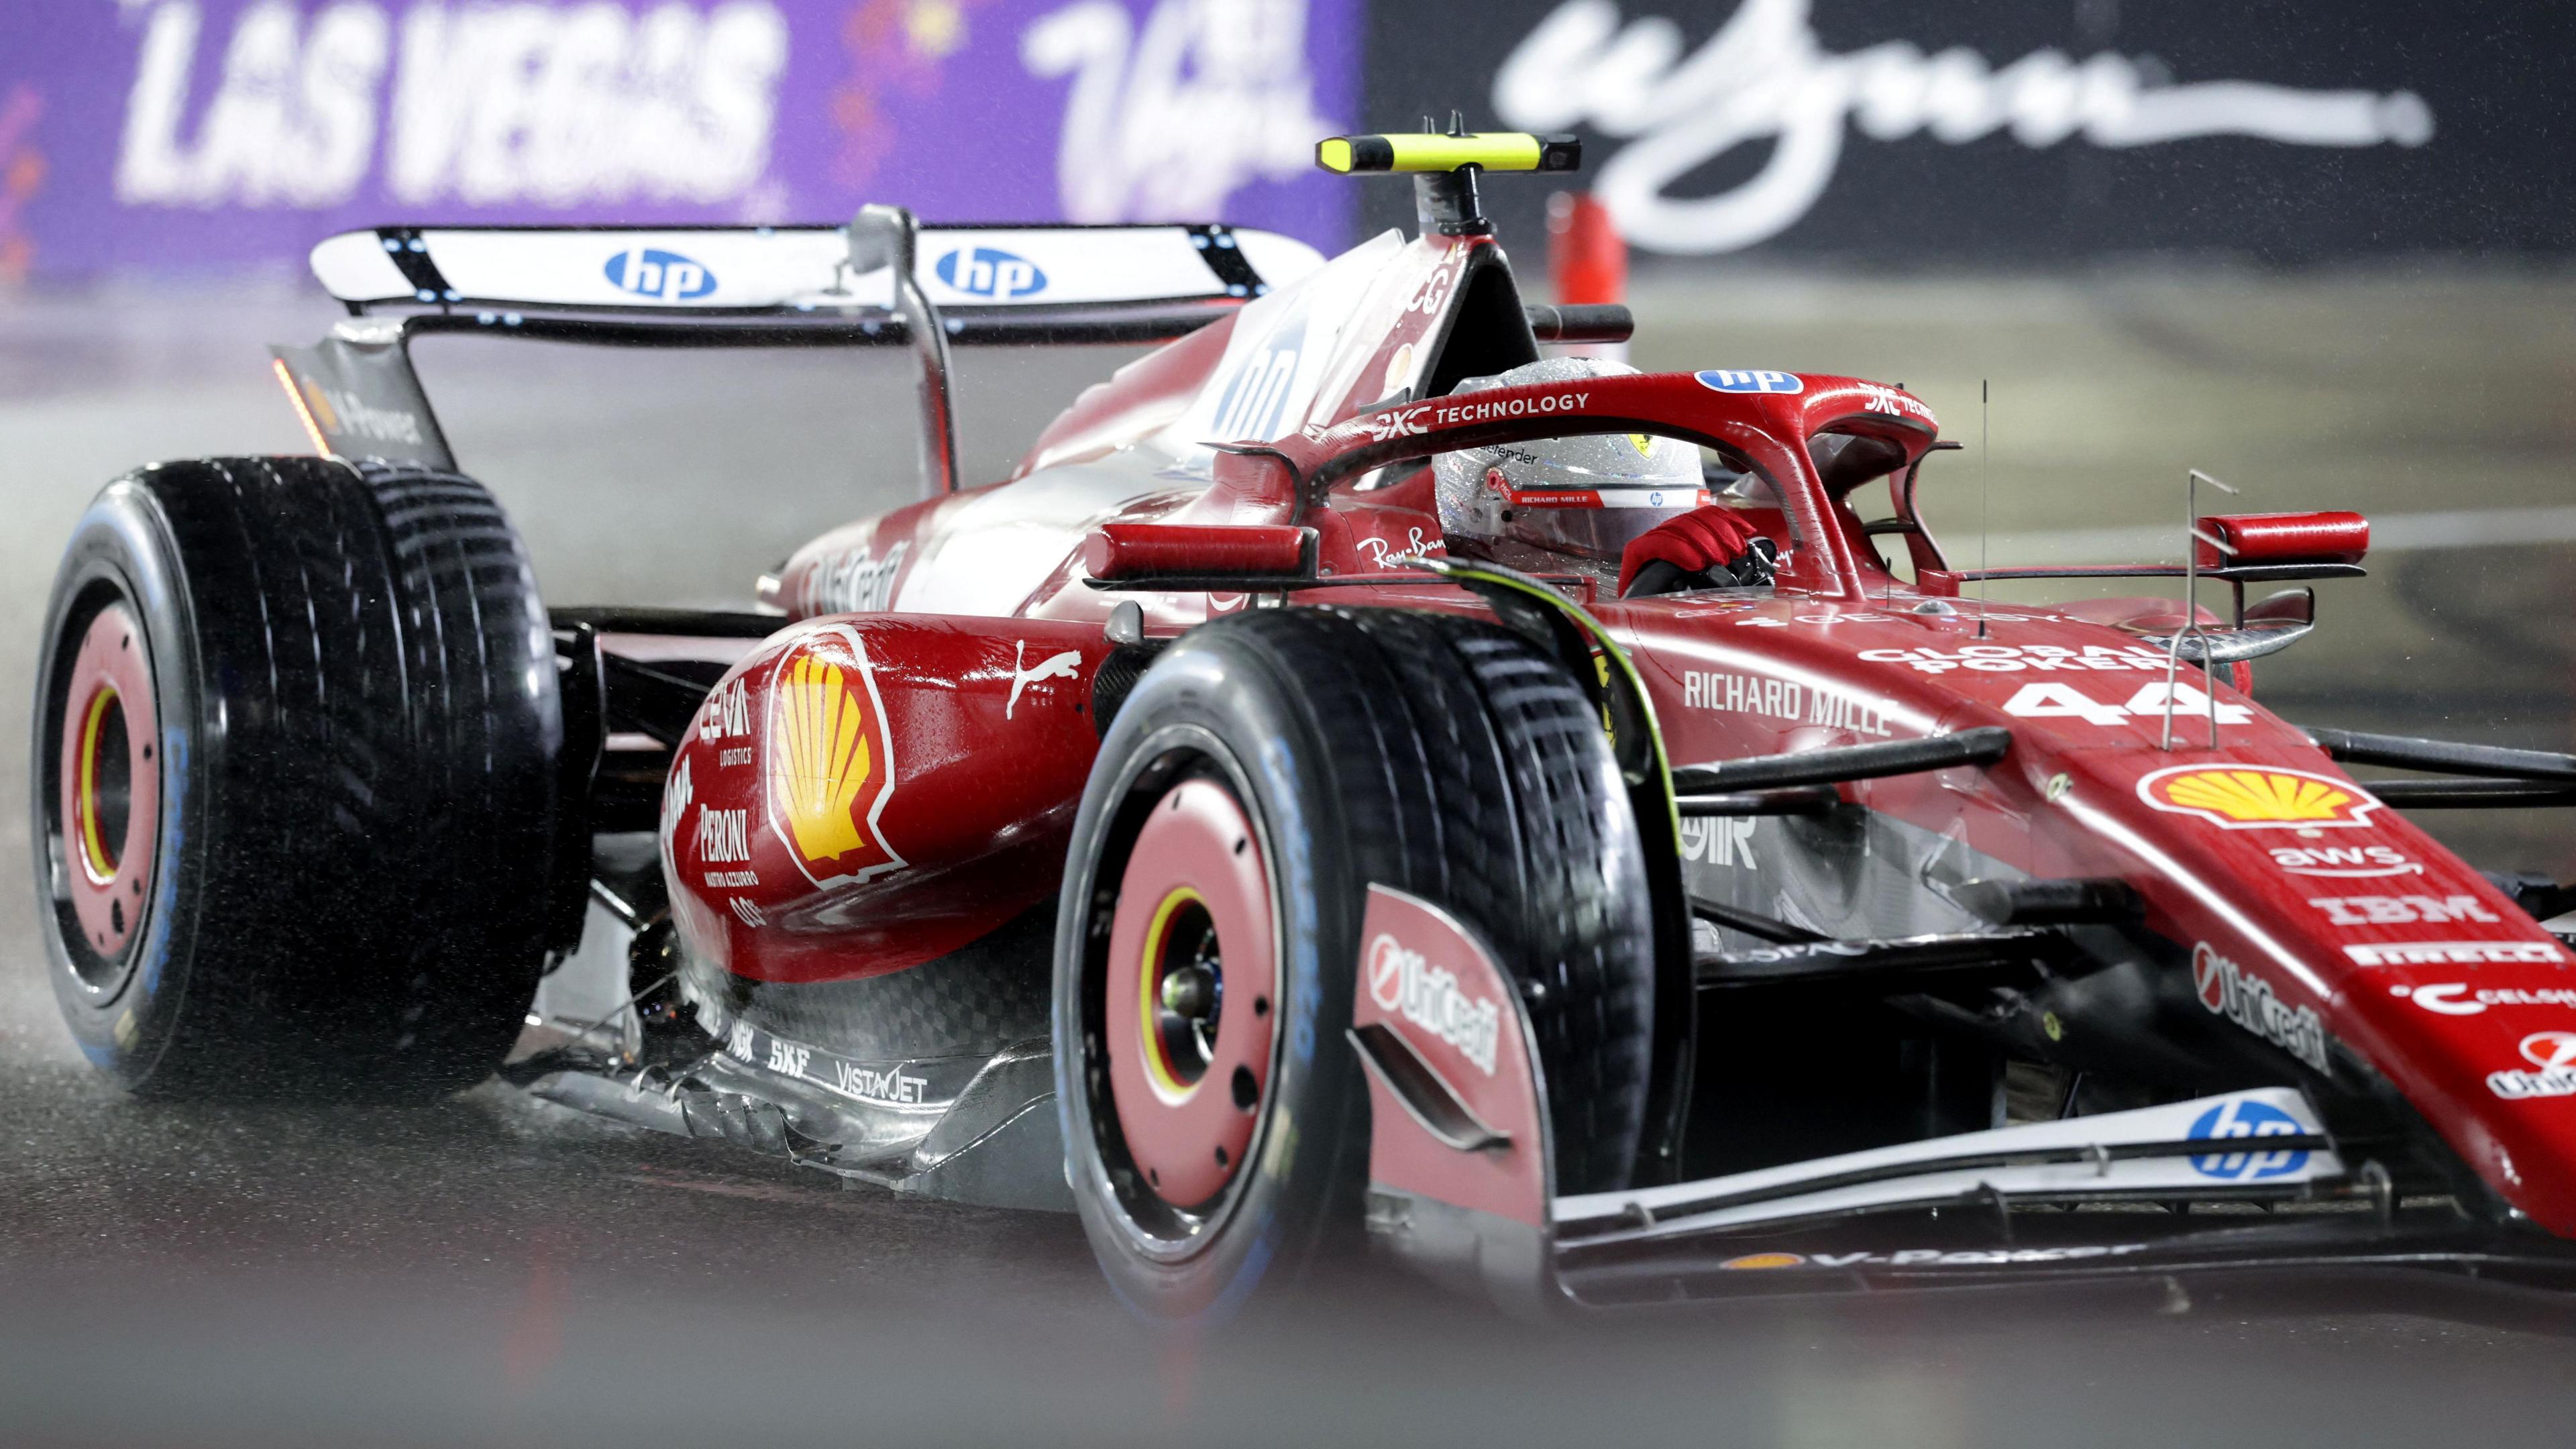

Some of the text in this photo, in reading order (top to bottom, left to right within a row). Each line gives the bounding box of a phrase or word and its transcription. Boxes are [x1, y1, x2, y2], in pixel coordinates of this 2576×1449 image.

[115, 0, 389, 208] LAS
[619, 249, 706, 300] hp
[951, 248, 1036, 297] hp
[1437, 393, 1589, 424] TECHNOLOGY
[1521, 495, 1588, 504] RICHARD MILLE
[1650, 492, 1663, 507] hp
[1858, 645, 2174, 662] GLOBAL
[1909, 657, 2185, 674] POKER
[1684, 670, 1898, 737] RICHARD MILLE
[2002, 682, 2255, 727] 44
[719, 747, 752, 767] LOGISTICS
[700, 803, 751, 863] PERONI
[2269, 846, 2406, 866] aws
[725, 869, 759, 888] AZZURRO
[2308, 894, 2501, 926] IBM
[2342, 941, 2566, 967] PIRELLI
[767, 1039, 810, 1079] SKF
